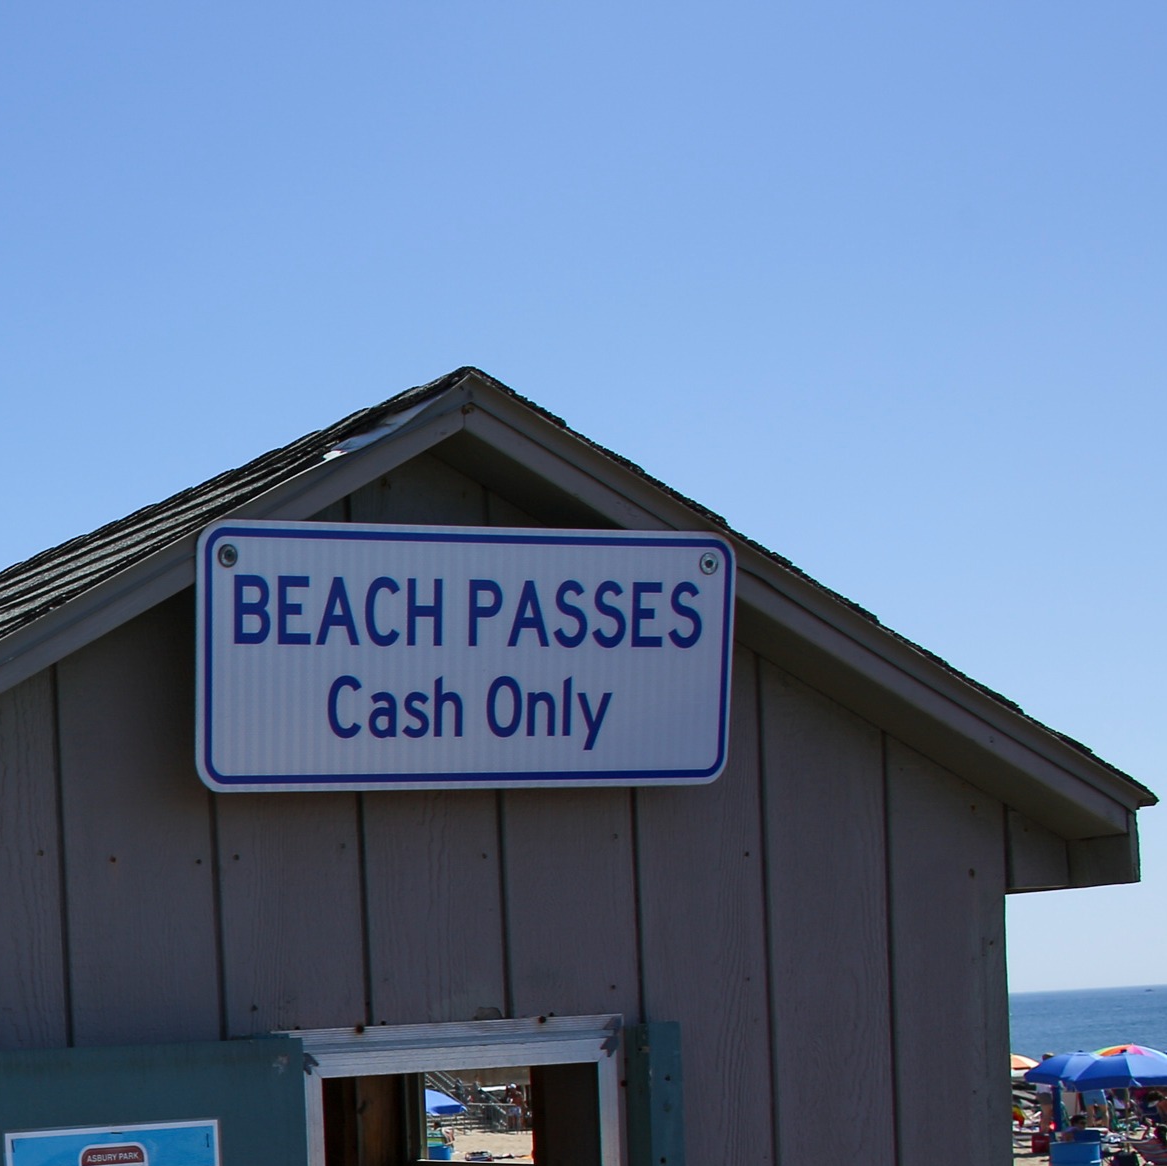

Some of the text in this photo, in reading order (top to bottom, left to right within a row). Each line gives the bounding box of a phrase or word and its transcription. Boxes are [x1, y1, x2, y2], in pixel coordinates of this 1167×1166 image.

[233, 574, 703, 649] BEACH PASSES
[326, 673, 614, 751] Cash Only
[86, 1151, 139, 1163] ASBURY PARK
